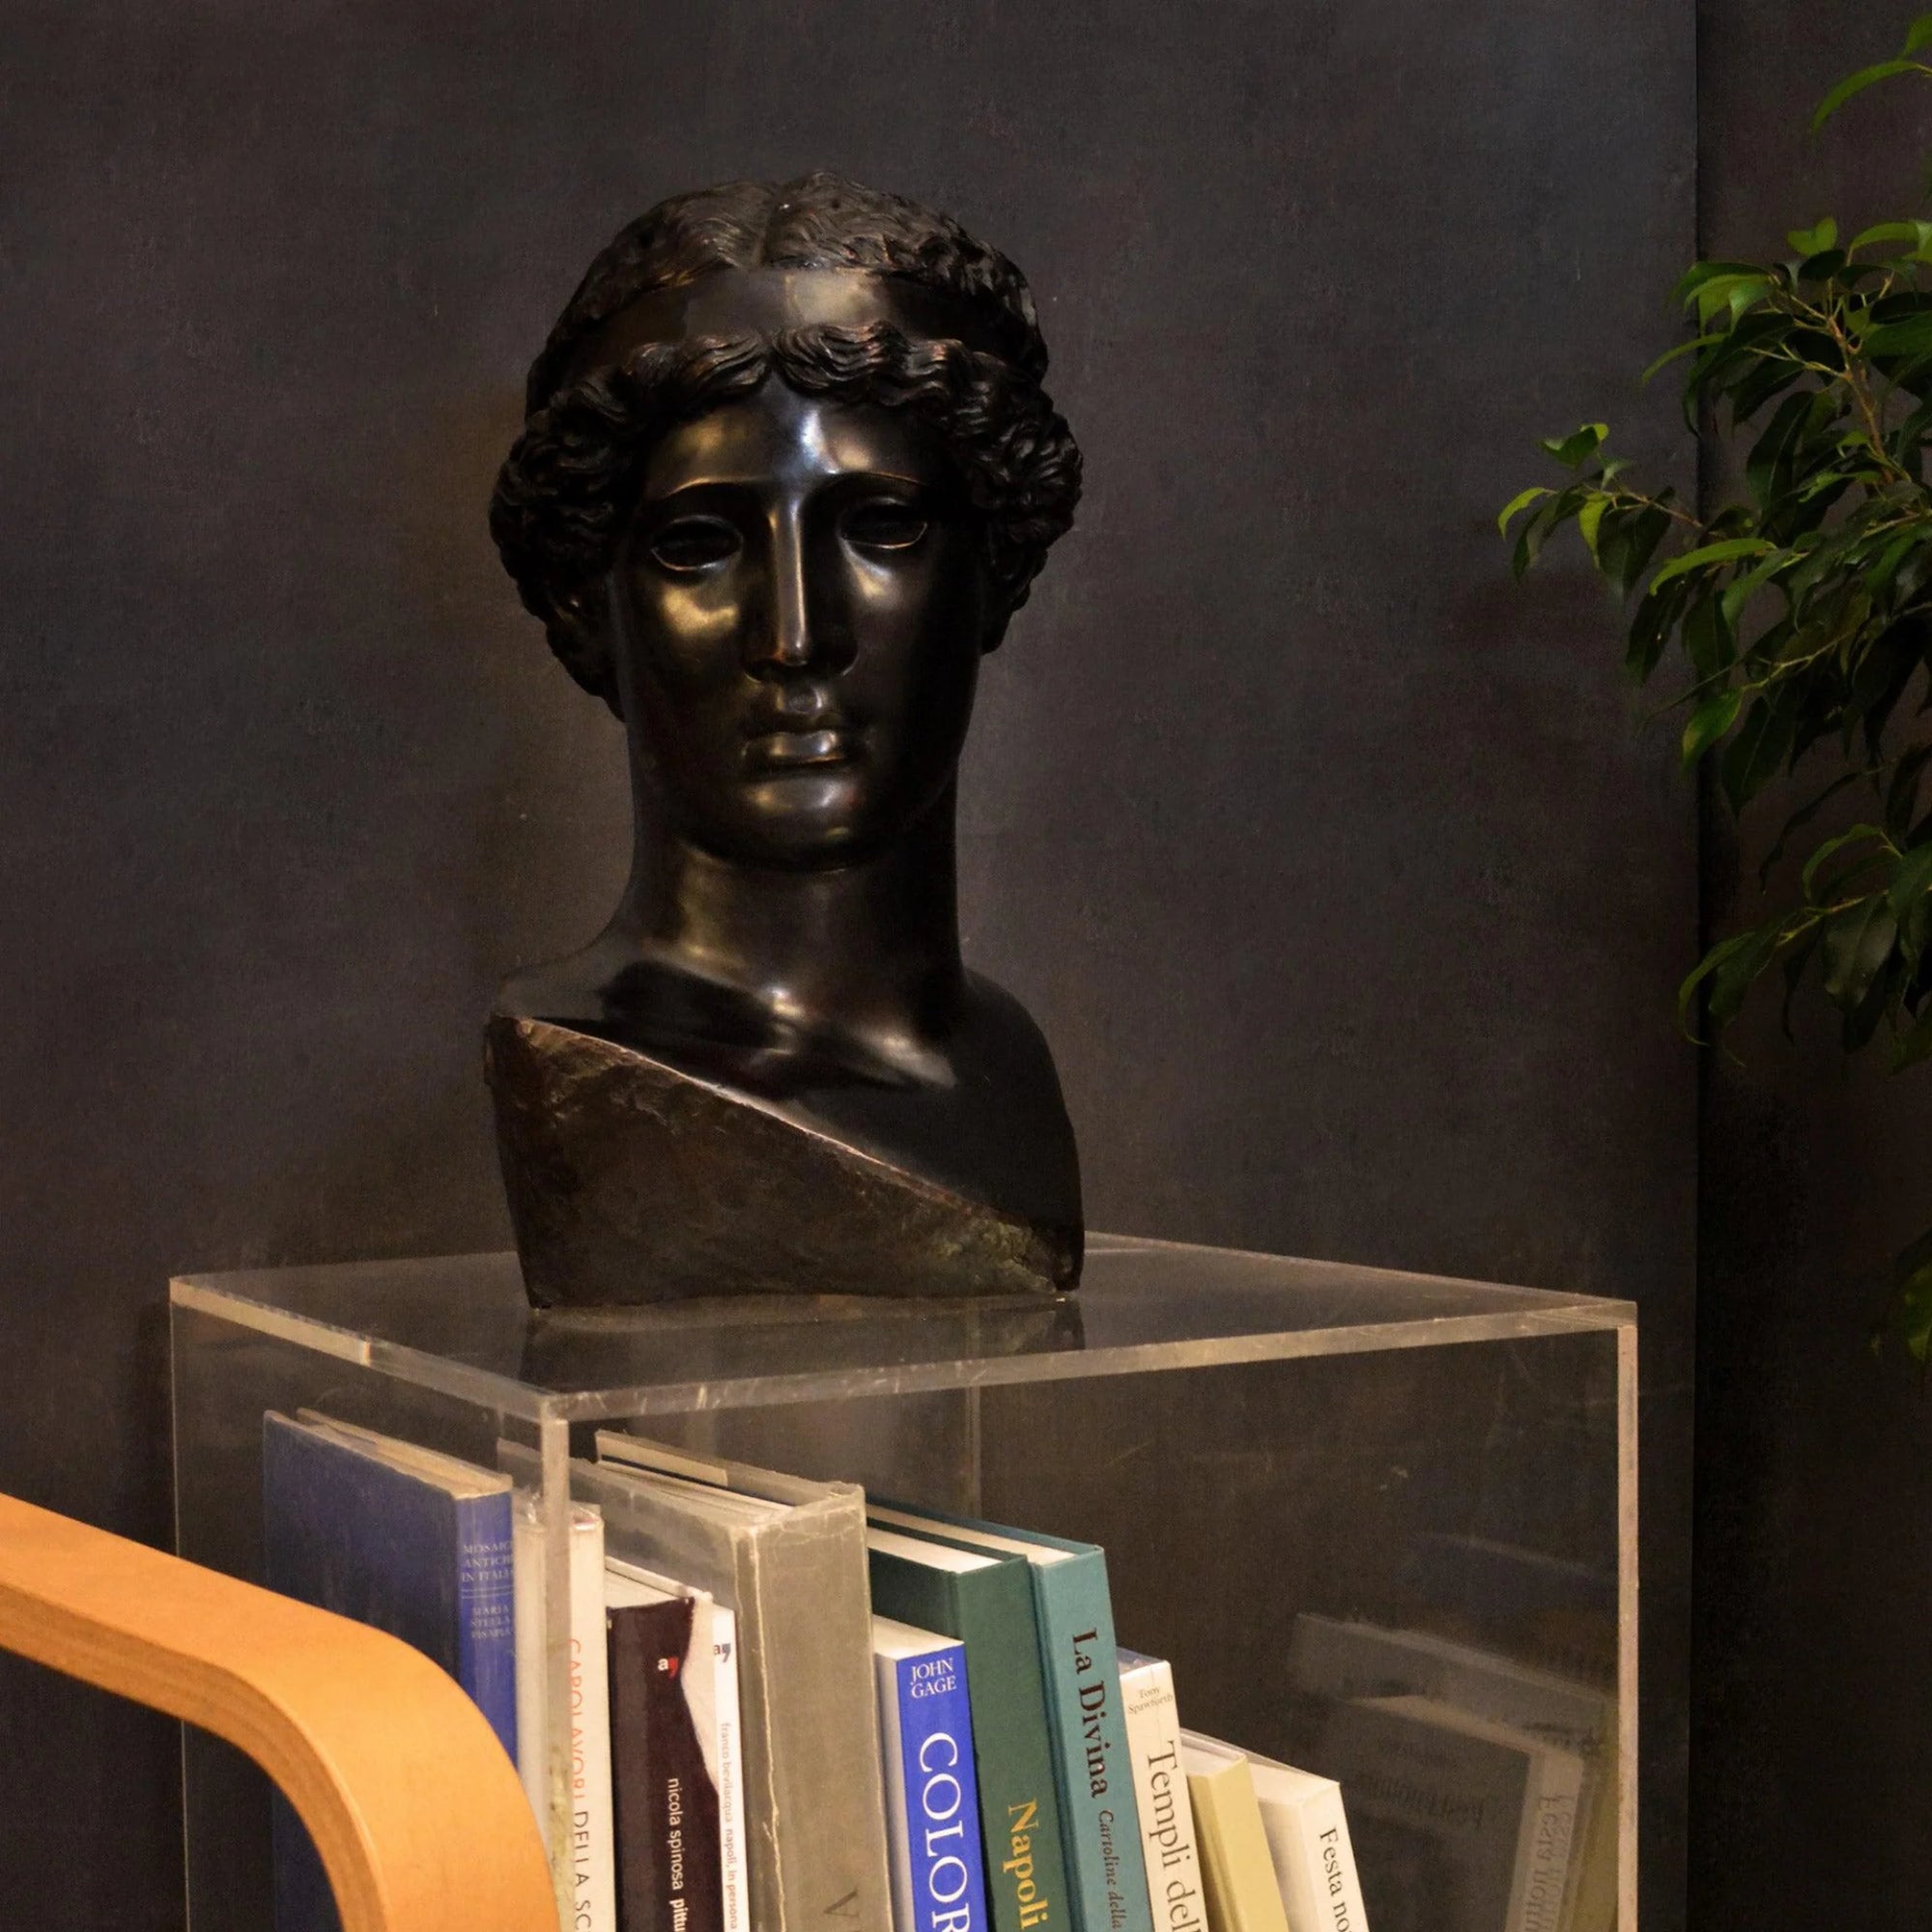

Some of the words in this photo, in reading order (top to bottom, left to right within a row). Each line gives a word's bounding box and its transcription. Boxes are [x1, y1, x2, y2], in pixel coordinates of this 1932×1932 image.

[462, 1572, 474, 1582] IN
[910, 1657, 953, 1686] JOHN
[1072, 1628, 1097, 1675] La
[911, 1675, 956, 1698] GAGE
[721, 1722, 732, 1759] franco
[1079, 1680, 1110, 1799] Divina
[668, 1777, 684, 1826] nicola
[1147, 1740, 1191, 1870] Templi
[920, 1732, 971, 1932] COLOR
[1098, 1809, 1120, 1886] Cartoline
[667, 1830, 686, 1890] spinosa
[727, 1870, 738, 1881] in
[1003, 1798, 1049, 1930] Napoli
[1320, 1825, 1343, 1896] Festa
[1333, 1901, 1352, 1932] no
[575, 1900, 591, 1932] SC
[668, 1898, 689, 1932] pittu
[726, 1884, 738, 1930] persona
[1108, 1890, 1127, 1930] della
[1166, 1880, 1203, 1932] del
